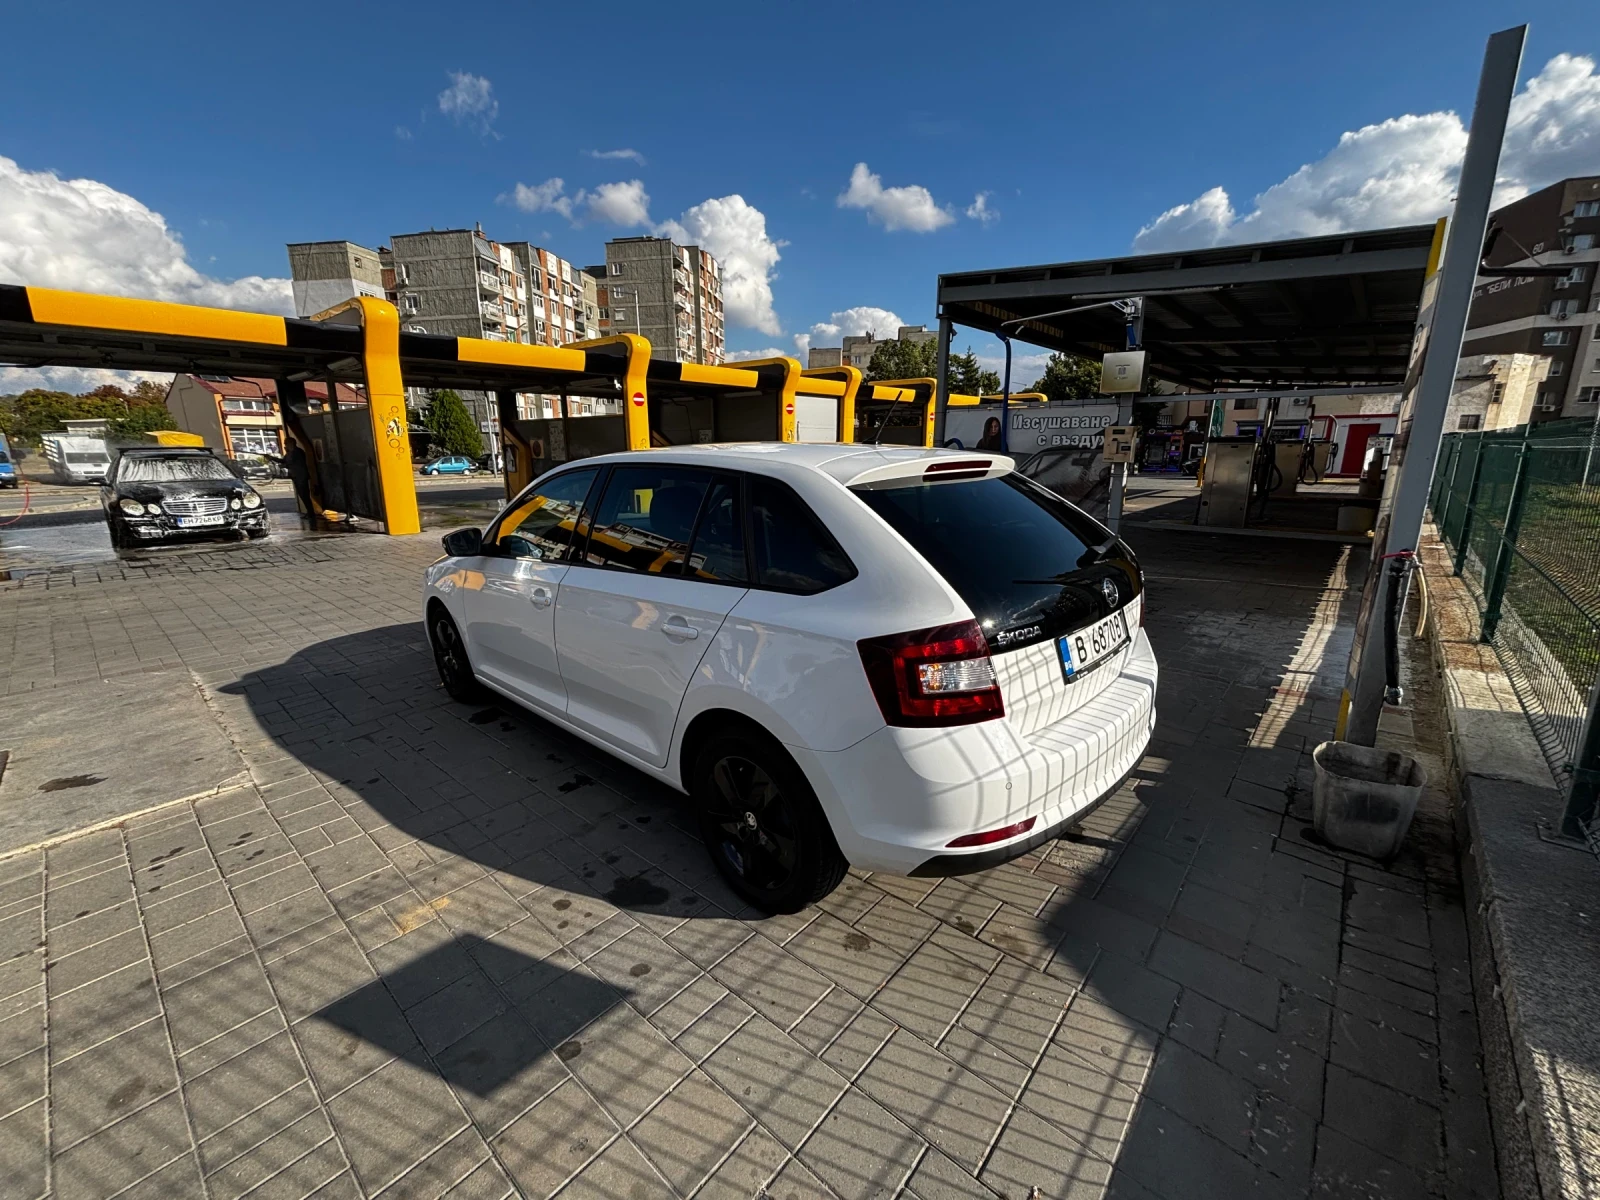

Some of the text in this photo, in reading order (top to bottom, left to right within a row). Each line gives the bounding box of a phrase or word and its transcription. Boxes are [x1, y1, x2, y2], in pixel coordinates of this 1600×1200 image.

[1012, 414, 1111, 433] Изсушаване
[1037, 434, 1048, 446] с
[1075, 612, 1122, 663] B 6870B
